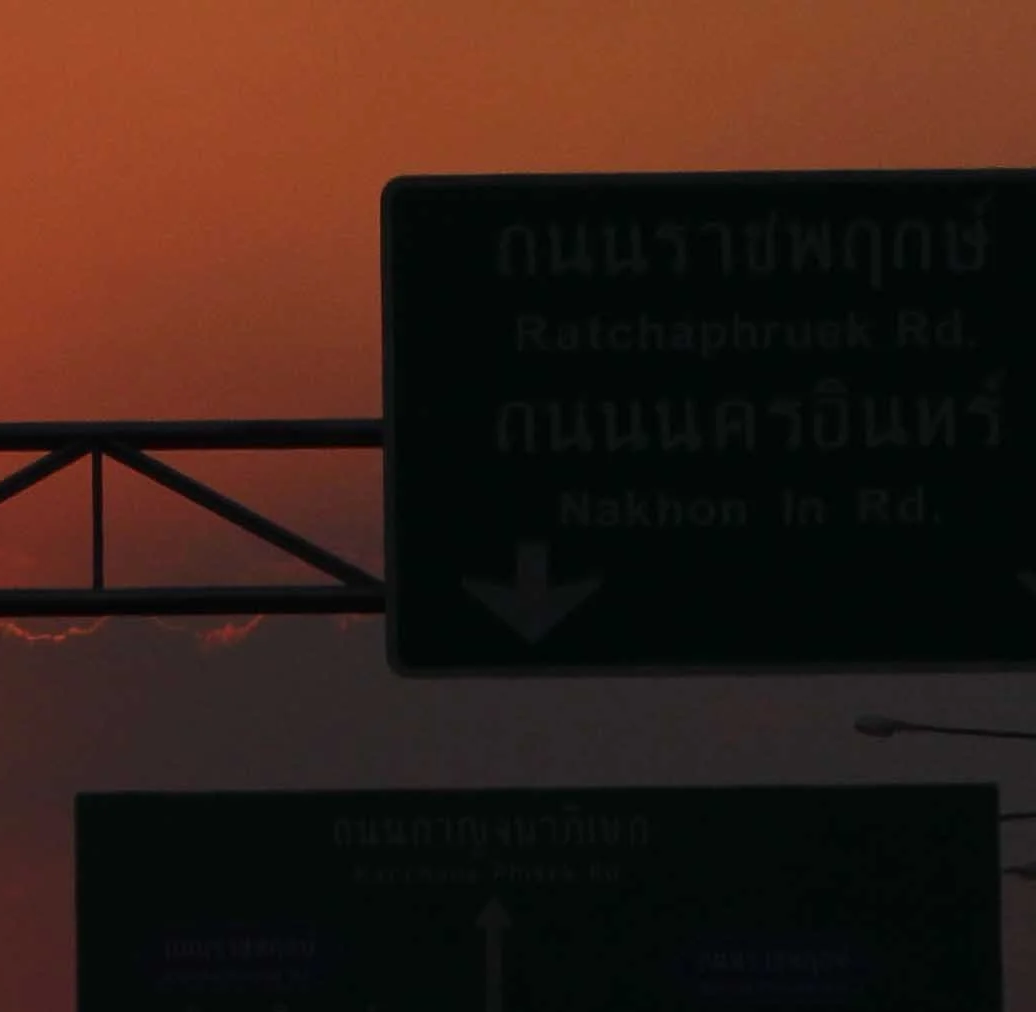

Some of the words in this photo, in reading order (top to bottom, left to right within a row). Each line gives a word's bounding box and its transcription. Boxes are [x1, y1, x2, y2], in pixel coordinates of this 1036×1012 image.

[494, 195, 996, 292] ถนนราชพฤกษ์
[514, 310, 872, 360] Ratchaphruek
[896, 307, 977, 352] Rd.
[494, 368, 1007, 454] ถนนนครอินทร์
[559, 489, 748, 528] Nakhon
[781, 488, 827, 526] In
[857, 485, 944, 527] Rd.
